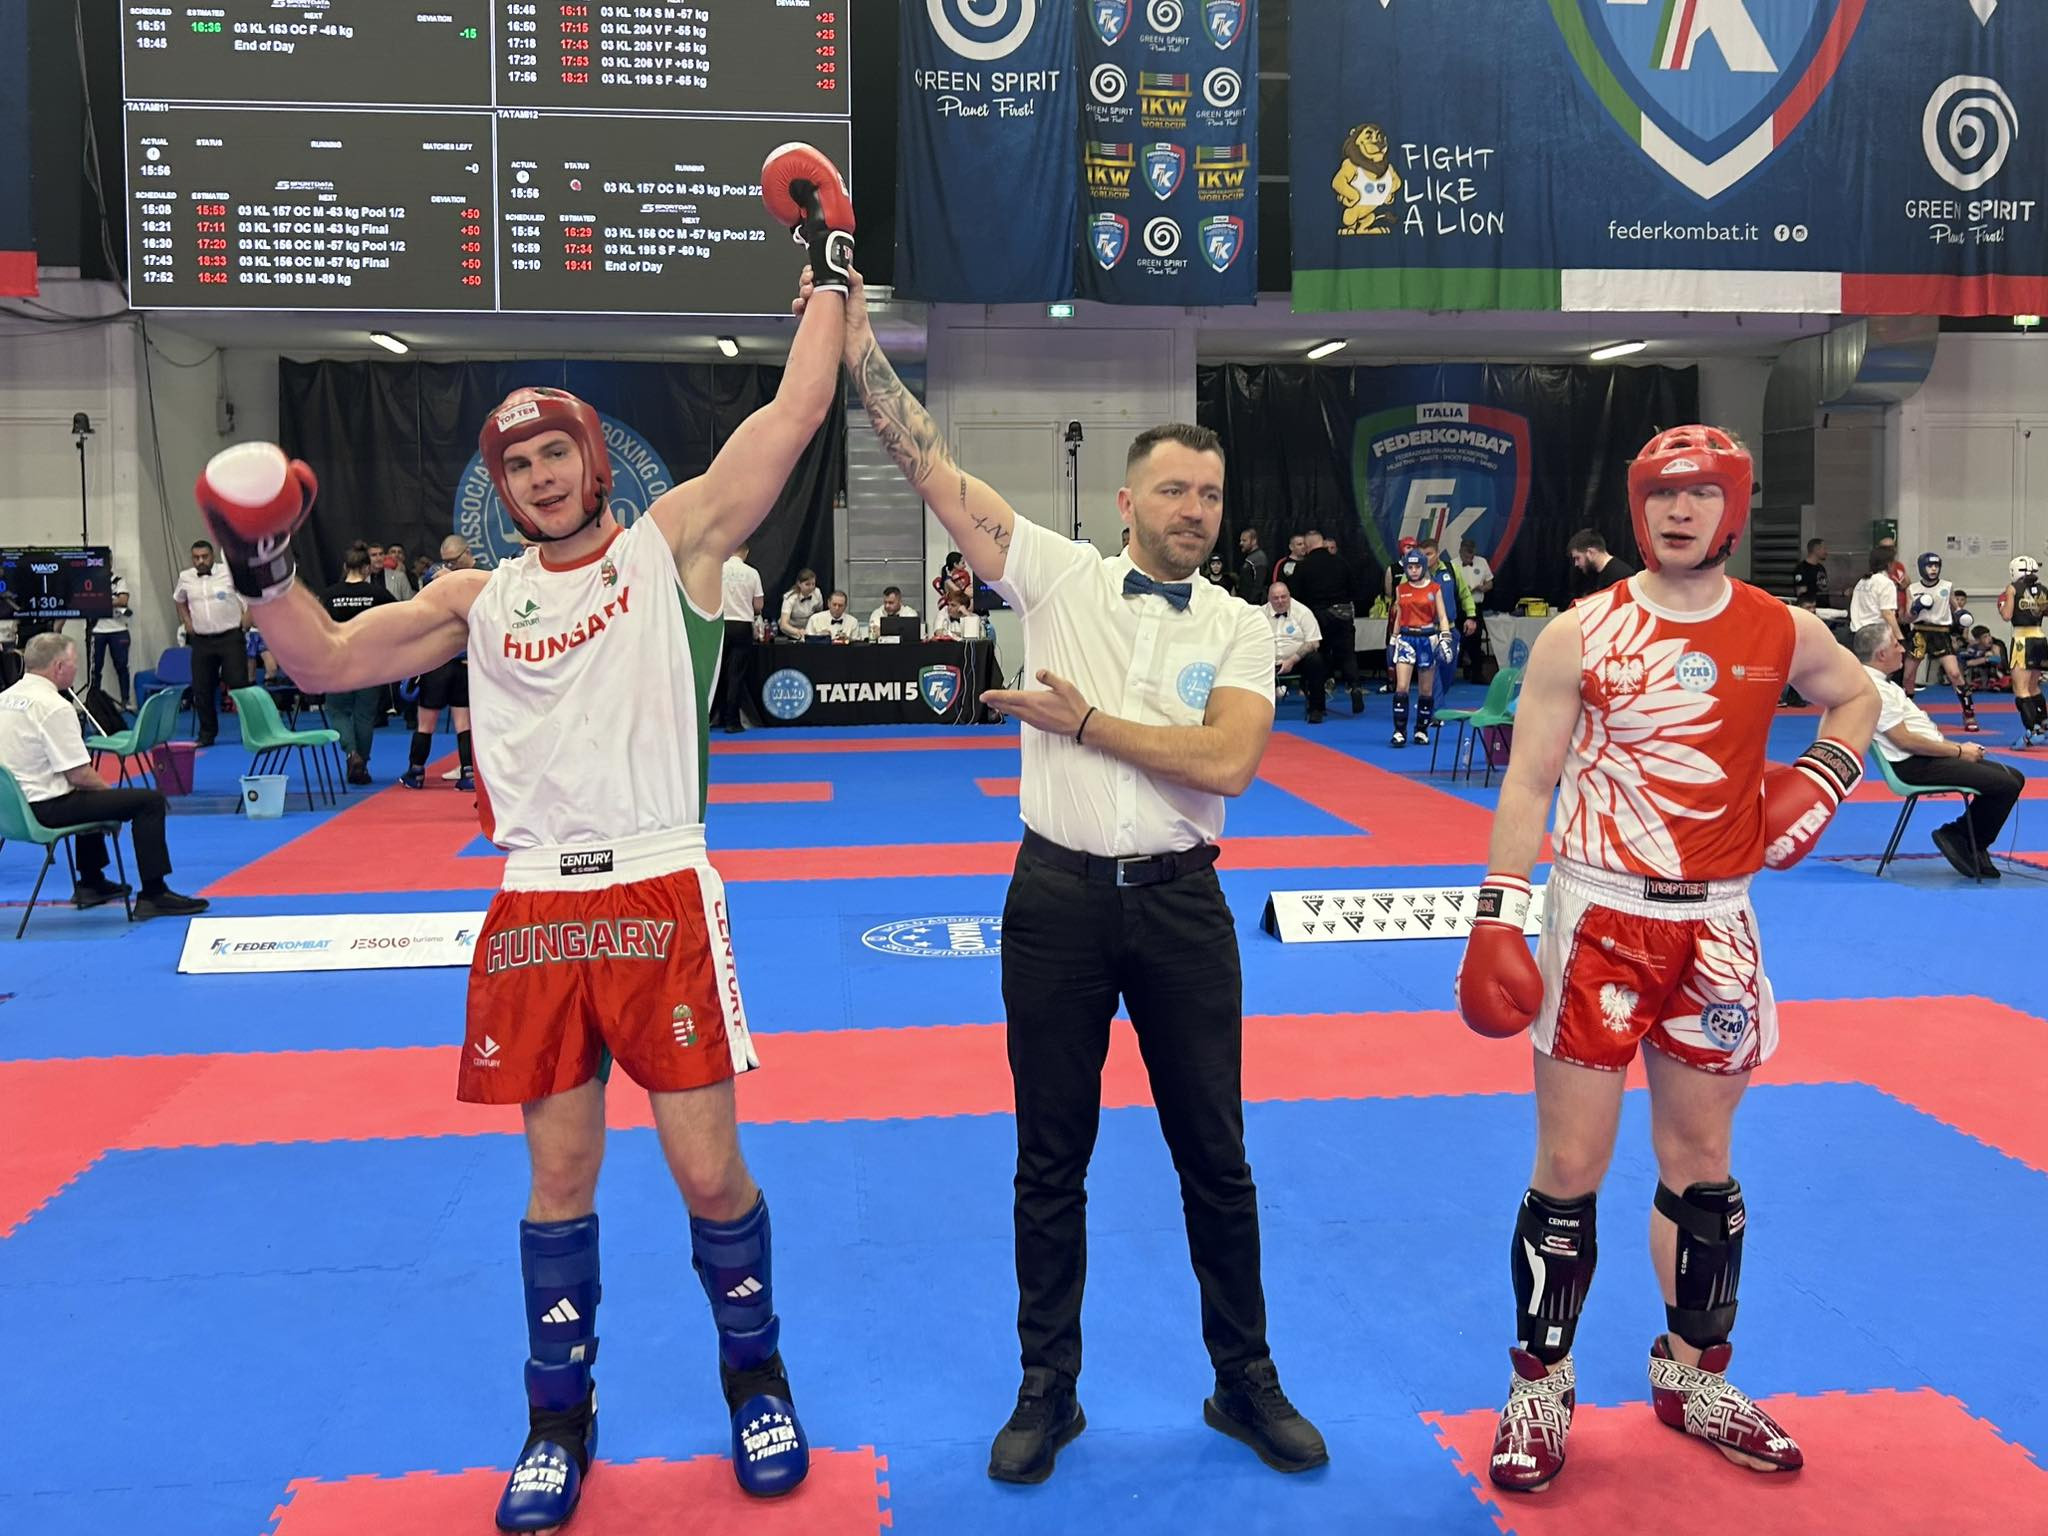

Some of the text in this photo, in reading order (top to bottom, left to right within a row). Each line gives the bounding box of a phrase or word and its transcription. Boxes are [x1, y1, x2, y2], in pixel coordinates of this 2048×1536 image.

[250, 23, 266, 34] KL
[290, 24, 307, 34] OC
[339, 25, 353, 38] kg
[616, 24, 632, 34] KL
[693, 26, 706, 38] kg
[235, 40, 257, 50] End
[273, 41, 294, 53] Day
[1140, 35, 1191, 45] GREEN SPIRIT
[616, 41, 632, 51] KL
[693, 43, 706, 55] kg
[914, 68, 1060, 93] GREEN SPIRIT
[936, 95, 1034, 118] Planet First!
[1110, 107, 1133, 115] SPIRIT
[1140, 97, 1188, 116] IKW
[1401, 144, 1495, 171] FIGHT
[1087, 166, 1131, 185] IKW
[1199, 169, 1245, 188] IKW
[1404, 176, 1478, 205] LIKE
[254, 206, 270, 216] KL
[293, 206, 311, 216] OC
[345, 207, 359, 219] kg
[361, 207, 388, 217] Pool
[1905, 199, 2036, 222] GREEN SPIRIT
[1403, 205, 1504, 237] A LION
[254, 223, 270, 233] KL
[294, 223, 311, 233] OC
[345, 224, 359, 236] kg
[362, 224, 388, 234] Final
[1607, 219, 1759, 241] federkombat.it
[620, 245, 635, 254] KL
[696, 246, 709, 258] kg
[605, 261, 626, 271] End
[642, 261, 663, 273] Day
[1136, 259, 1188, 268] GREEN SPIRIT
[499, 406, 536, 426] TOP TEN
[1422, 407, 1463, 419] ITALIA
[1372, 428, 1512, 458] FEDERKOMBAT
[1682, 666, 1711, 678] PZKB
[816, 681, 918, 704] TATAMI 5
[561, 852, 611, 867] CENTURY
[233, 939, 333, 952] FEDERKOMBAT
[350, 935, 444, 950] JESOLO turismo
[486, 919, 674, 973] HUNGARY
[1710, 1012, 1743, 1034] PZKB
[1548, 1216, 1580, 1228] CENTURY
[756, 1440, 792, 1461] FIGHT
[516, 1482, 554, 1493] FIGHT
